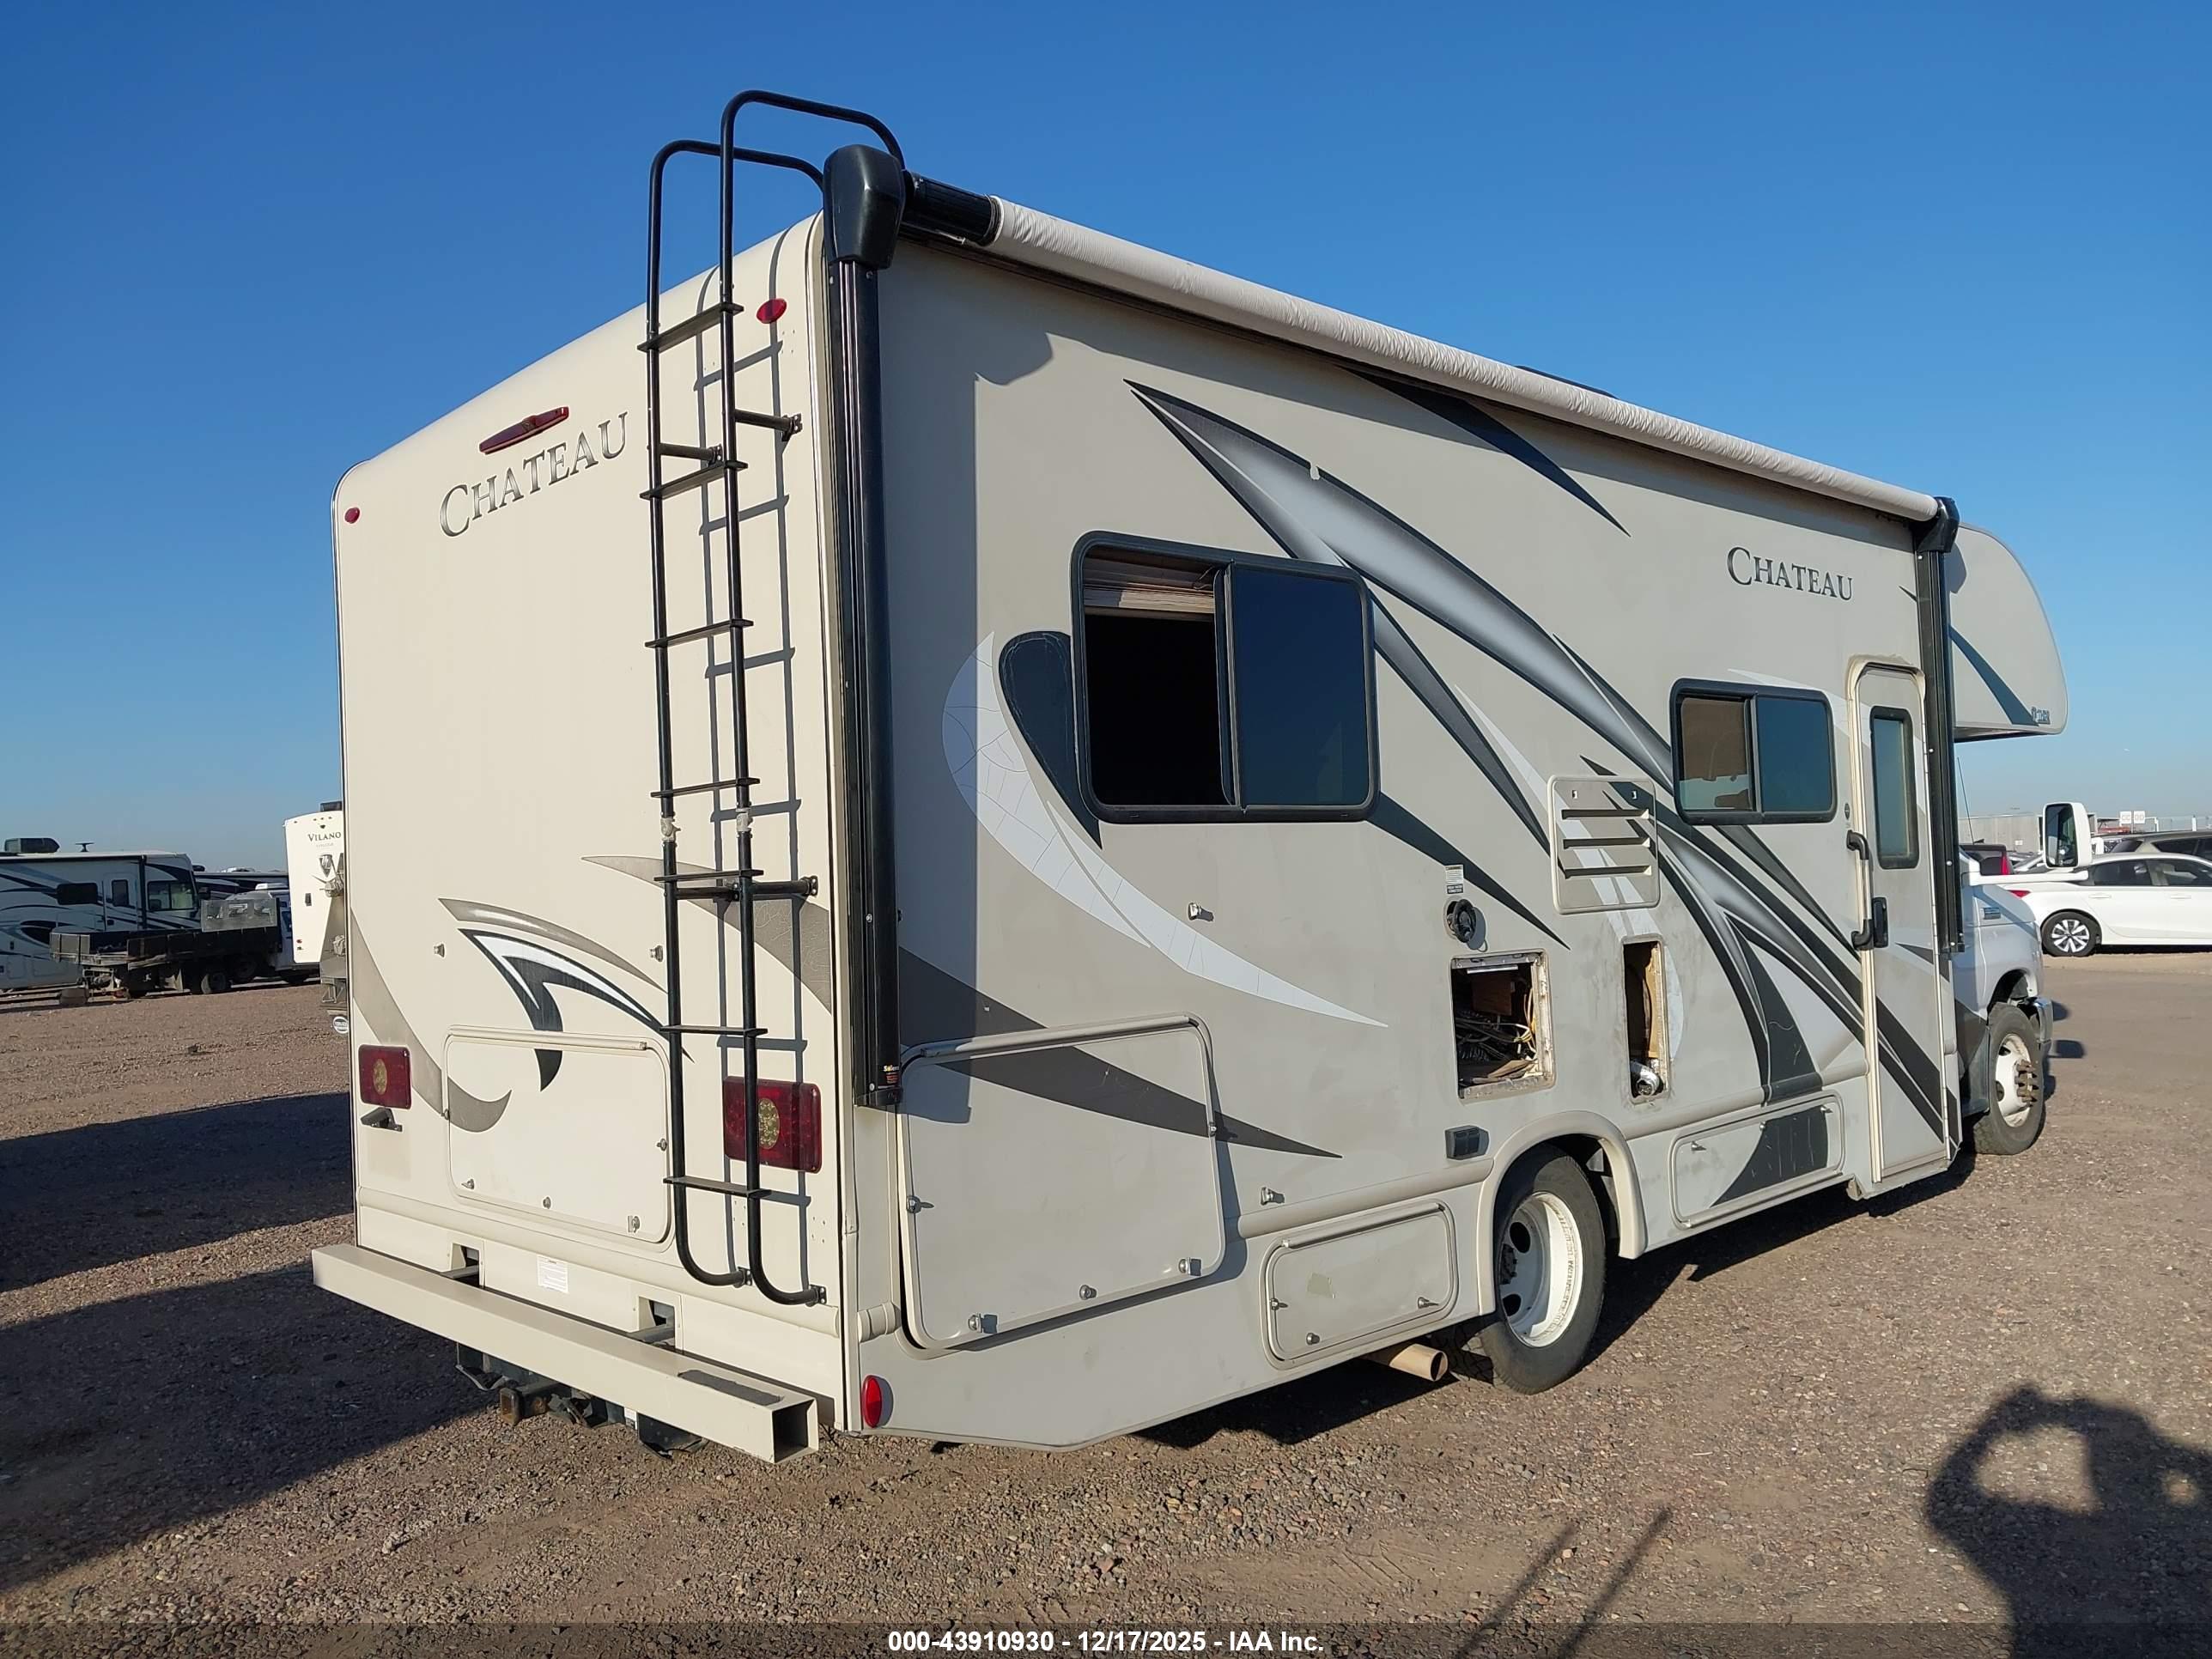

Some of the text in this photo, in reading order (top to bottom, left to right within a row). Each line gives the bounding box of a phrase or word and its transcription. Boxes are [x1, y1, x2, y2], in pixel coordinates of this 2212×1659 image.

[440, 411, 628, 537] CHATEAU
[1727, 546, 1853, 601] CHATEAU
[307, 831, 342, 842] VILANO
